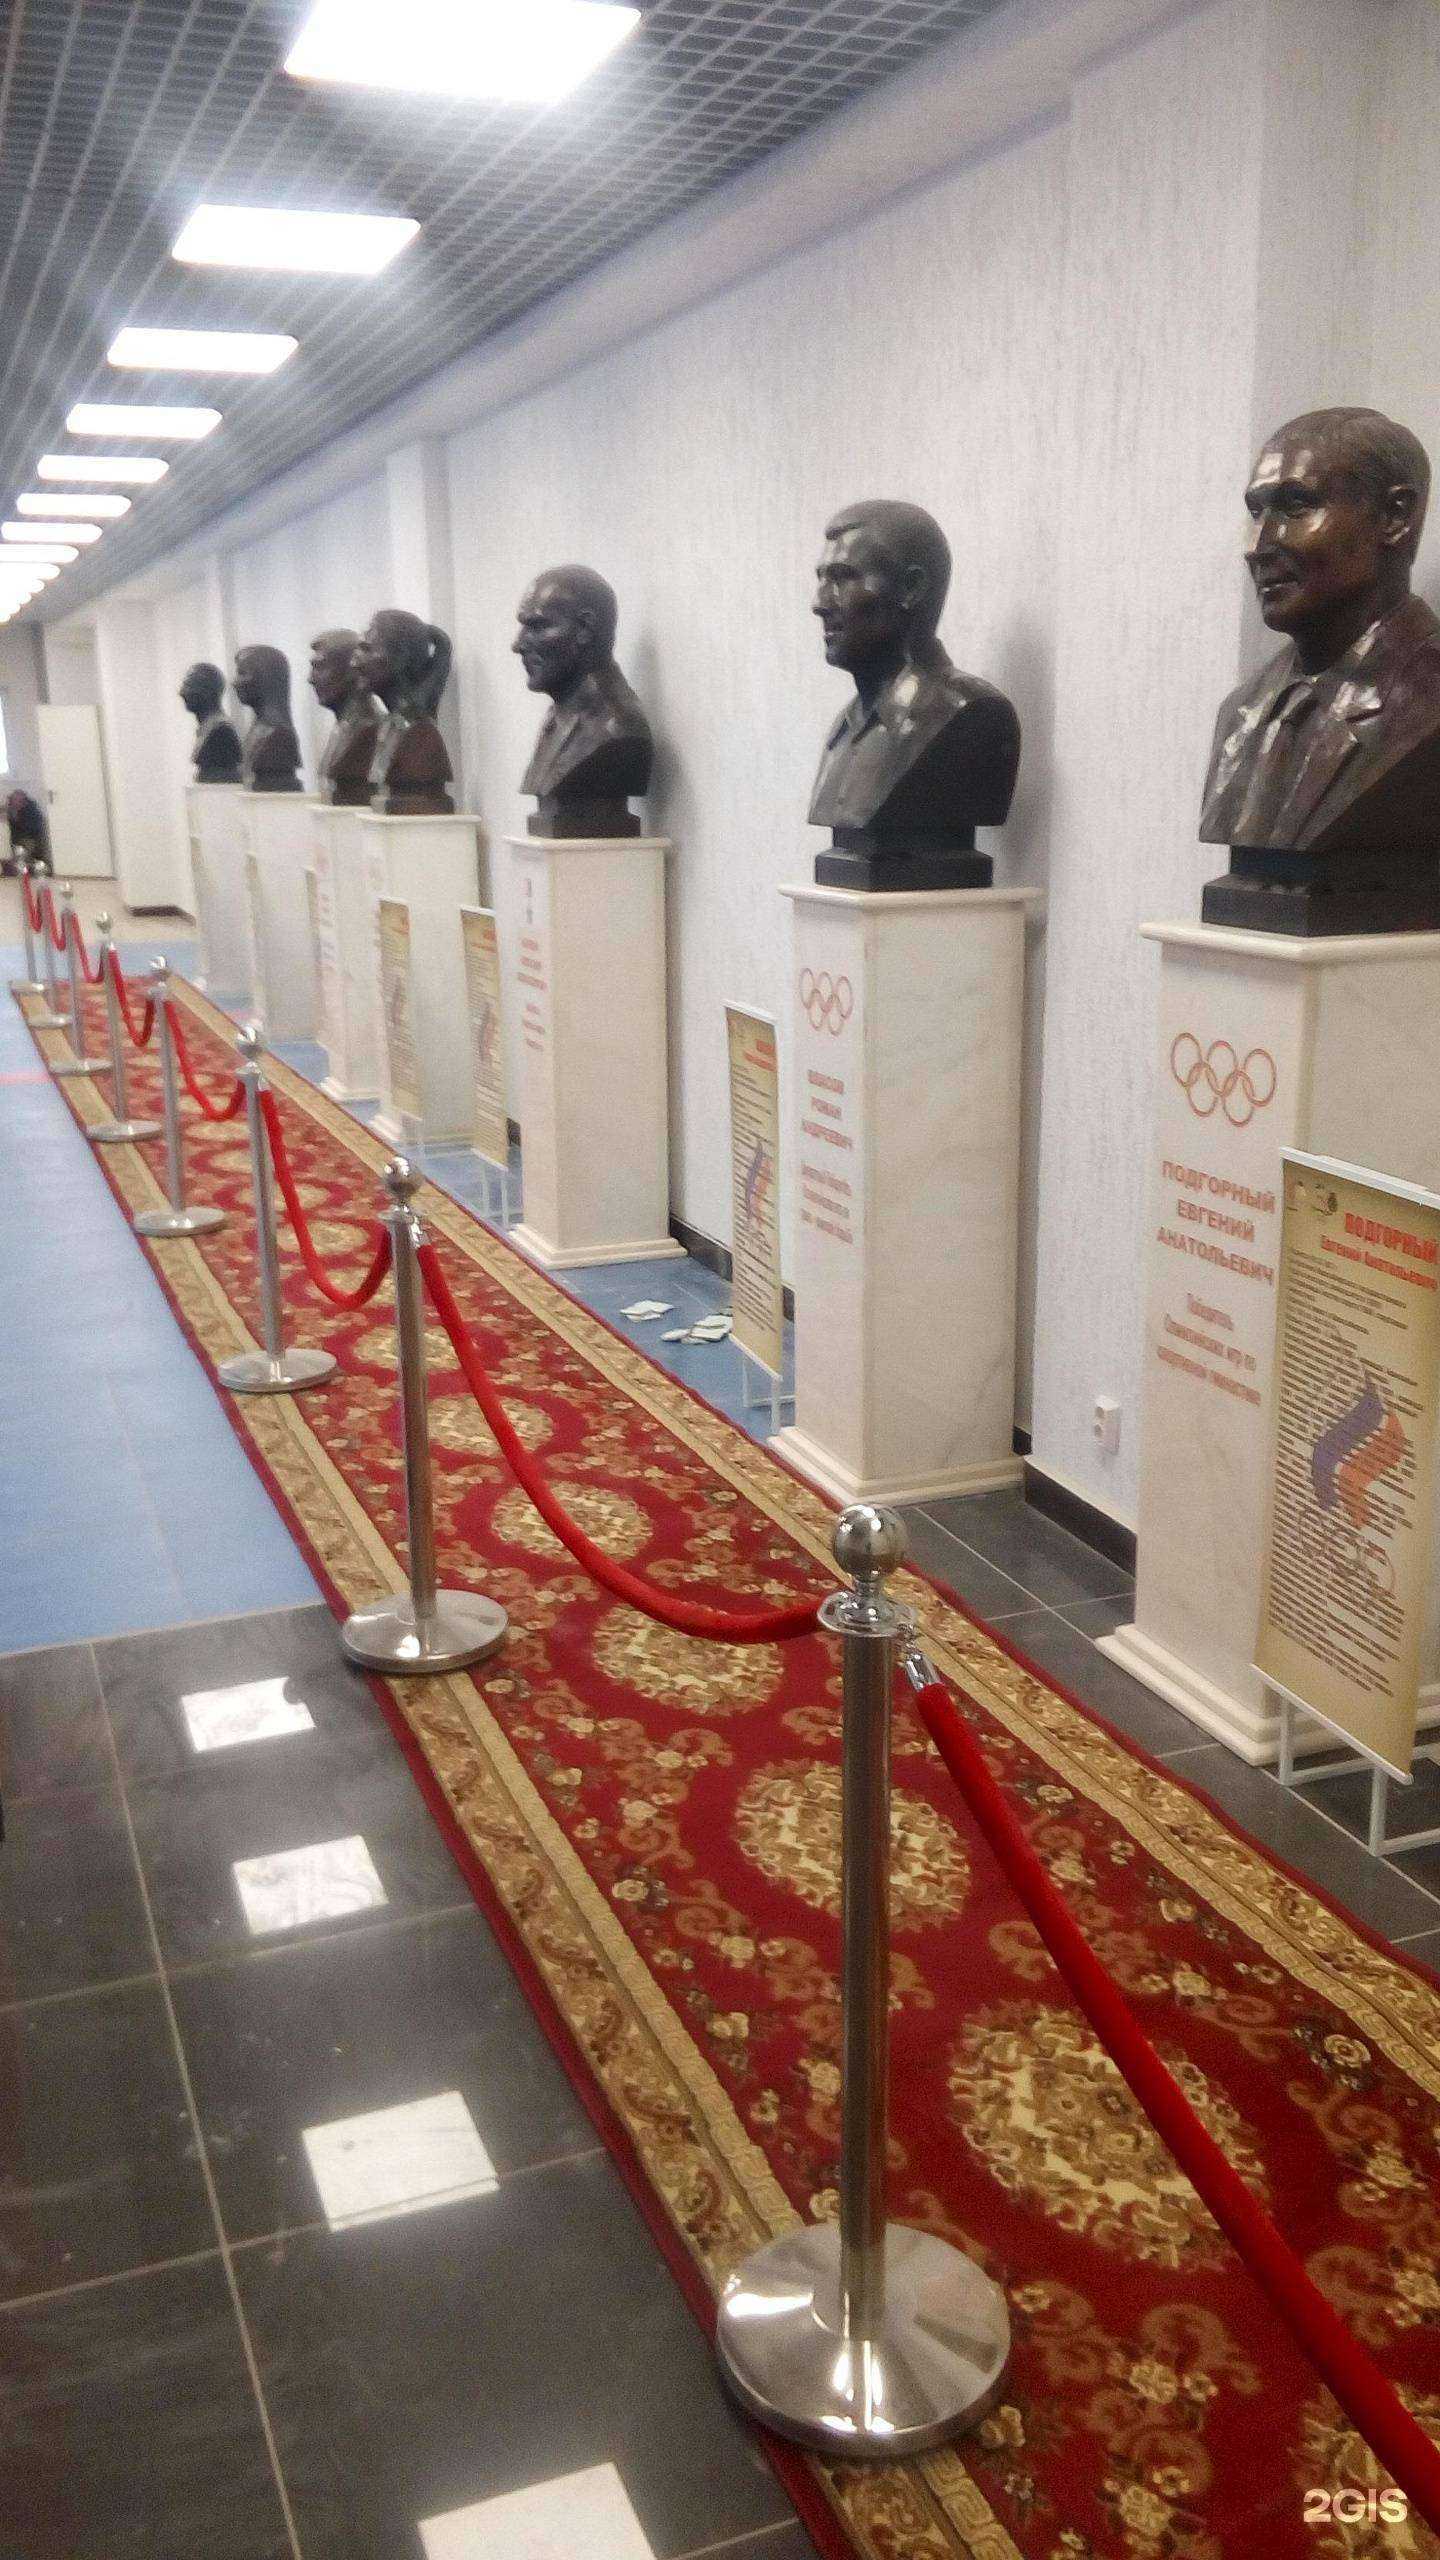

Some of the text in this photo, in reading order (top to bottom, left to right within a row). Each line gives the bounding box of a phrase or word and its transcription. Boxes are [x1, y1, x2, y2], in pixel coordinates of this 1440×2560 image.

[1162, 1160, 1275, 1214] ПОДГОРНЫЙ
[1177, 1198, 1255, 1242] ЕВГЕНИЙ
[1157, 1226, 1275, 1286] АНАТОЛЬЕВИЧ
